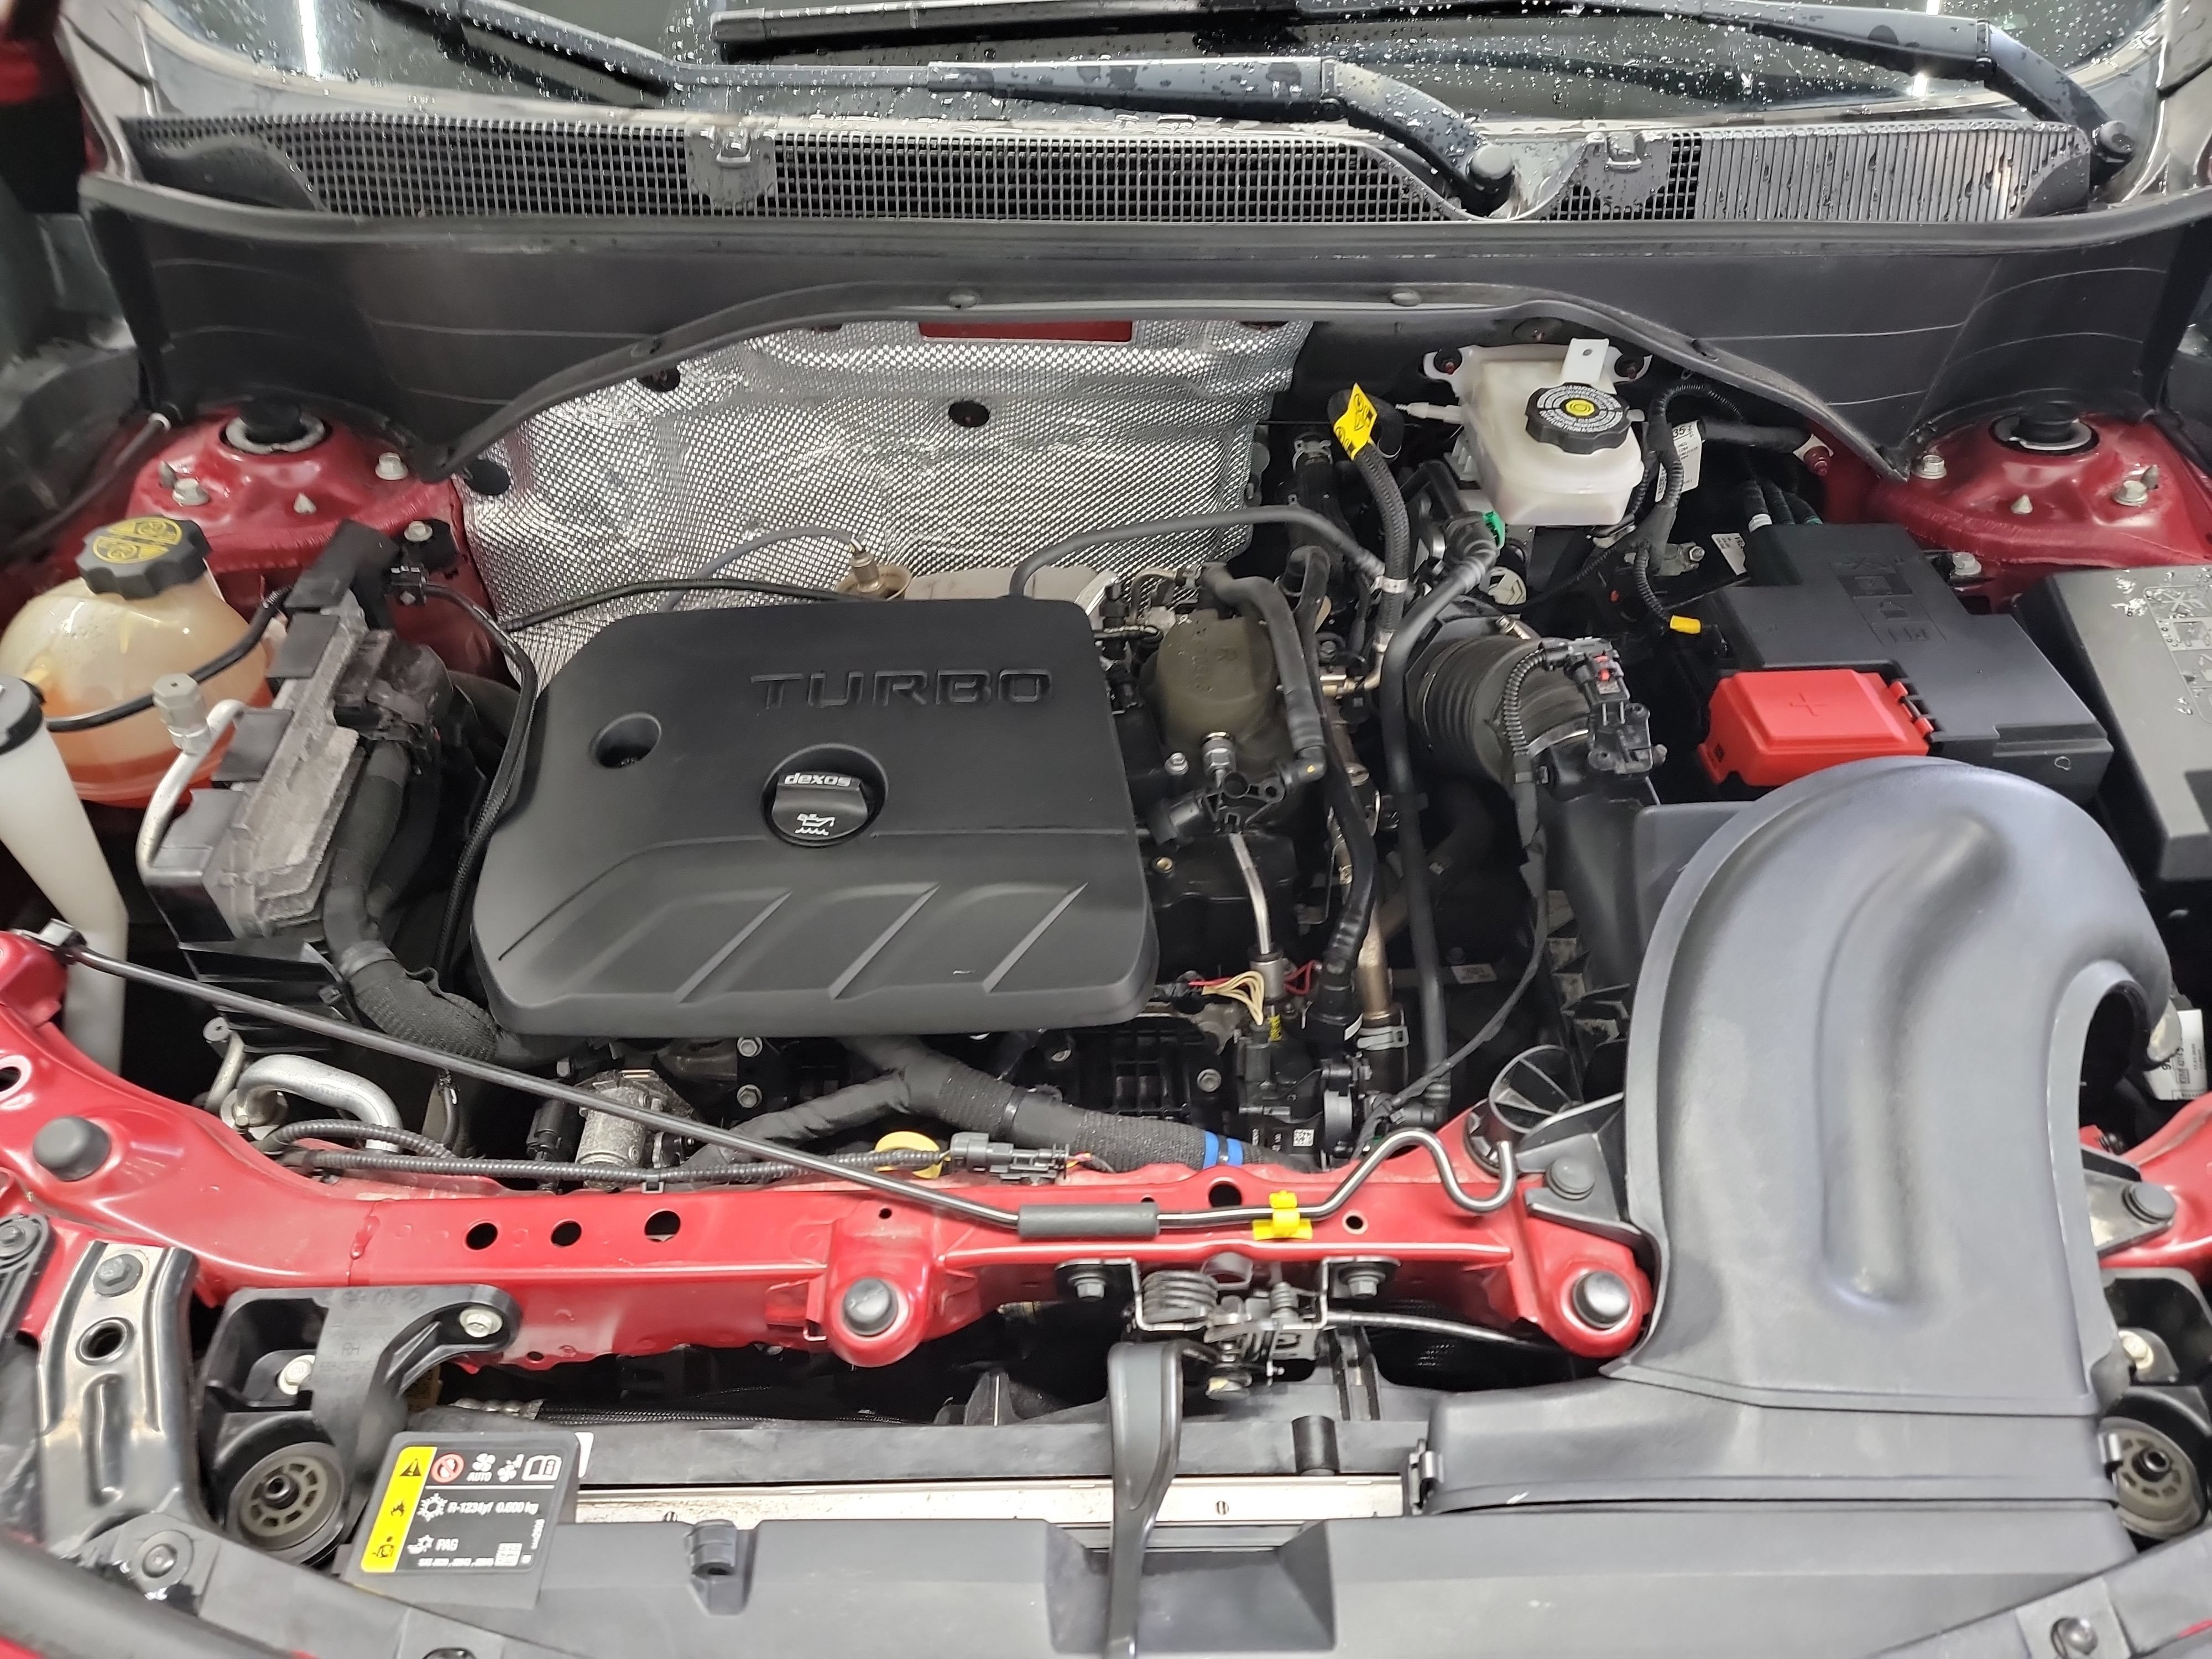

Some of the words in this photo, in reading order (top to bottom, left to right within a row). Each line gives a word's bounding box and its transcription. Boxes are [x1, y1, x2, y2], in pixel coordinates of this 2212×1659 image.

[751, 669, 1051, 710] TURBO
[784, 773, 852, 787] dexos
[467, 1472, 492, 1482] AUTO
[524, 1501, 539, 1515] kg
[436, 1538, 459, 1551] PAG
